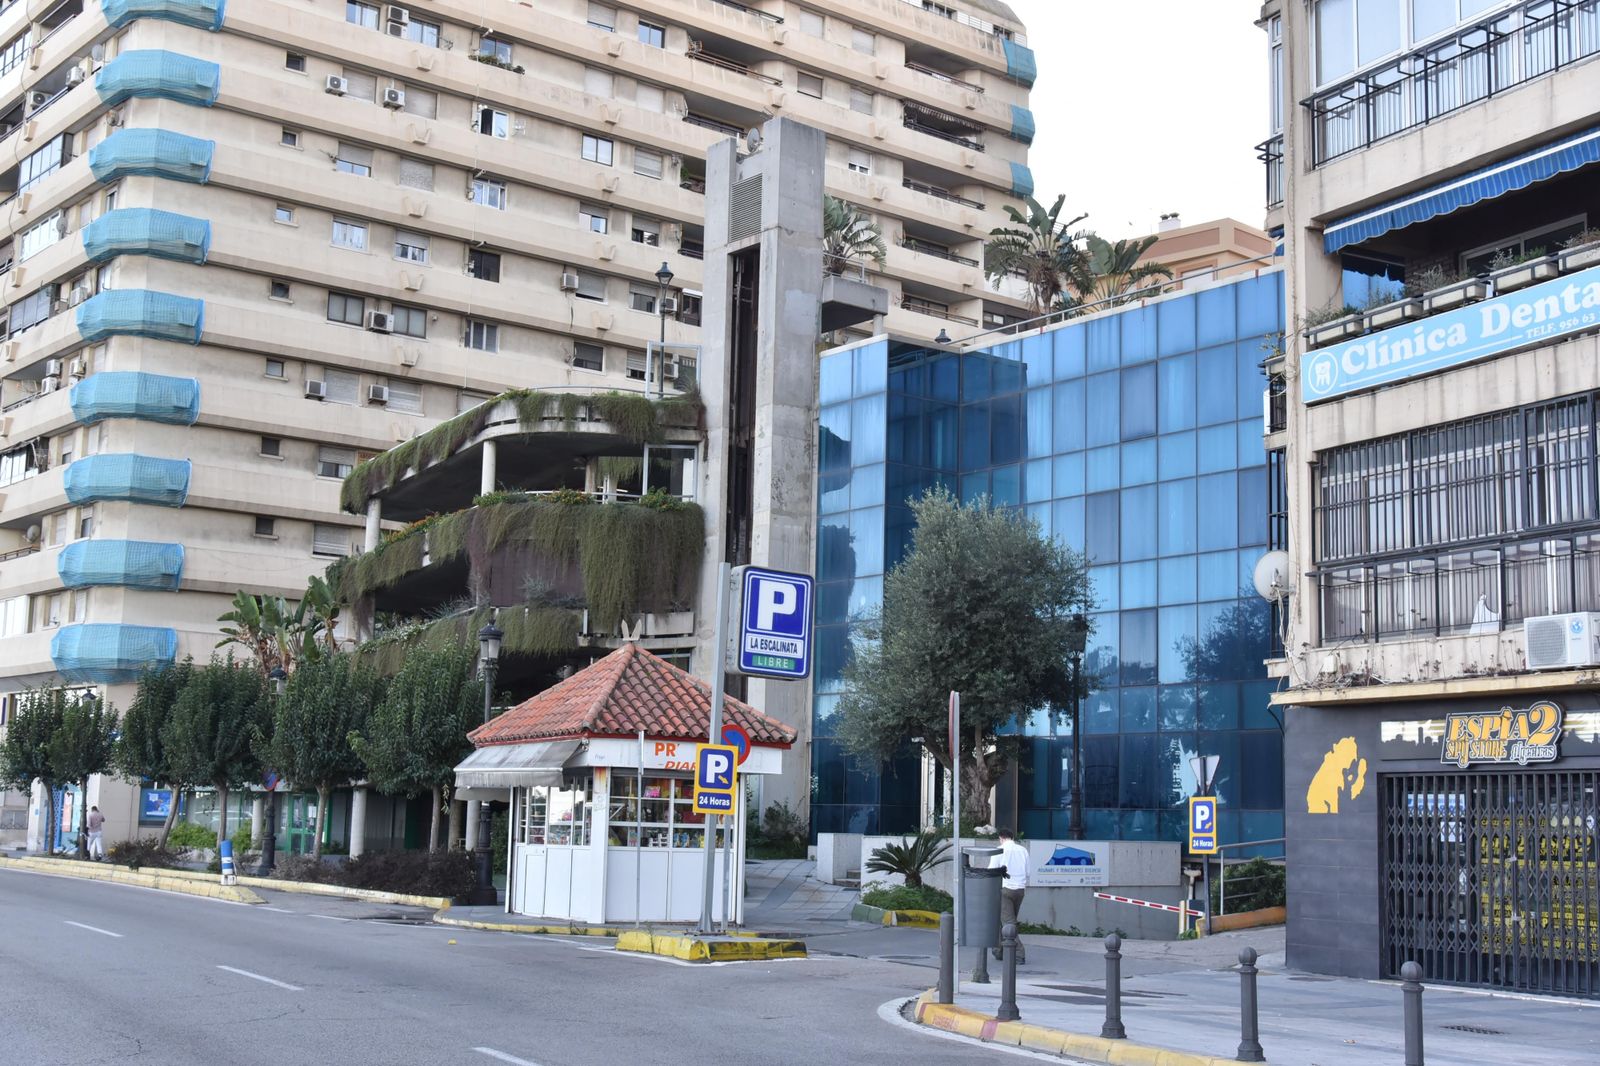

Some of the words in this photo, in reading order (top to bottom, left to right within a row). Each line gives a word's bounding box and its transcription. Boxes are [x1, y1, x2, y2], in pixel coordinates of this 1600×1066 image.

[1525, 322, 1557, 339] TELF.
[1559, 316, 1579, 330] 956
[1341, 323, 1468, 375] Clínica
[757, 579, 797, 631] P
[750, 637, 759, 649] LA
[760, 638, 798, 654] ESCALINATA
[757, 655, 789, 668] LIBRE
[1470, 740, 1508, 759] STORE
[706, 753, 728, 784] P
[698, 796, 708, 805] 24
[709, 796, 731, 806] Horas
[1195, 805, 1210, 830] P
[1192, 839, 1199, 848] 24
[1200, 839, 1213, 848] Horas
